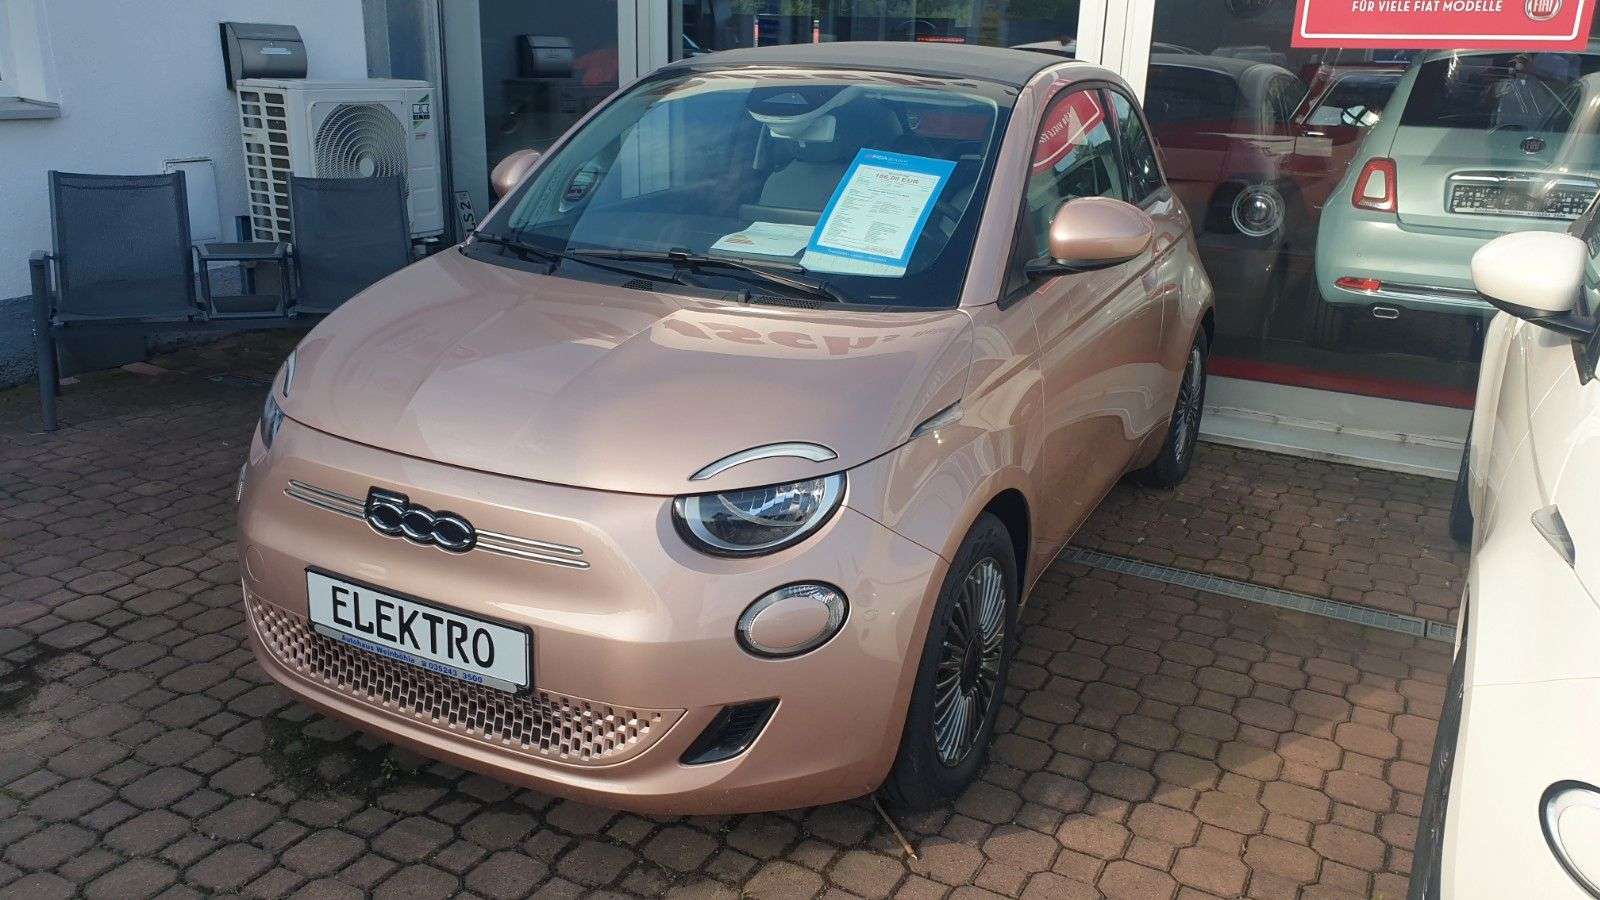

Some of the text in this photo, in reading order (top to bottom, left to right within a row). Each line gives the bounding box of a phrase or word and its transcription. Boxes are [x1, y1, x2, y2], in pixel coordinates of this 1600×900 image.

[1379, 0, 1410, 12] VIELE
[1414, 0, 1440, 12] FIAT
[1443, 0, 1503, 12] MODELLE
[1532, 0, 1555, 12] FIAT
[365, 486, 476, 553] 500
[332, 585, 495, 669] ELEKTRO
[462, 671, 484, 684] 3500
